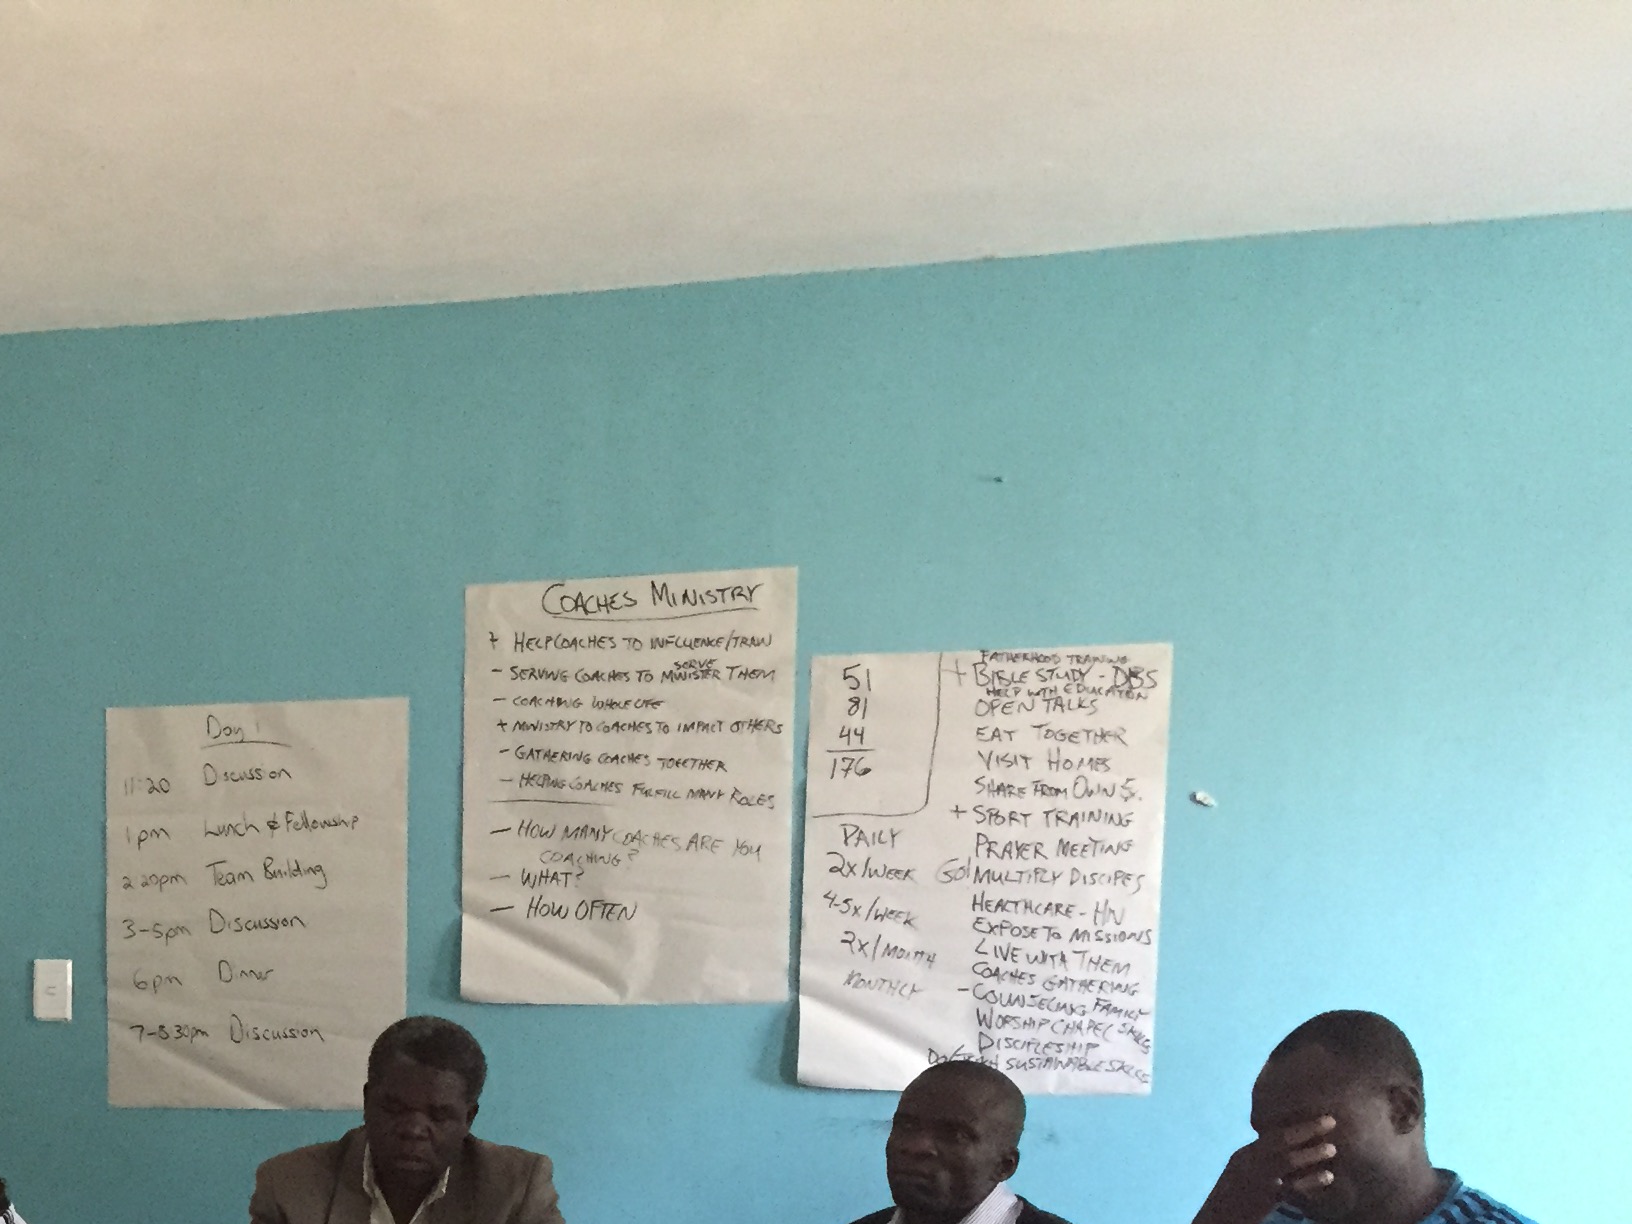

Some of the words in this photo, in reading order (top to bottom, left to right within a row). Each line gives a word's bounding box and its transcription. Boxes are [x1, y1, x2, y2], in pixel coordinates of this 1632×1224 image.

[541, 582, 638, 617] COACHES
[650, 580, 765, 608] MINISTRY
[621, 636, 644, 652] TO
[510, 664, 570, 683] SERVING
[574, 666, 632, 684] COACHES
[636, 668, 654, 684] TO
[725, 664, 776, 683] THEM
[841, 663, 873, 692] 51
[973, 662, 1031, 688] BIBLE
[1035, 664, 1095, 683] STUDY
[846, 696, 869, 721] 81
[974, 697, 1036, 718] OPEN
[1041, 694, 1100, 717] TALKS
[578, 719, 594, 734] TO
[654, 719, 670, 735] TO
[676, 719, 724, 734] IMPACT
[730, 717, 784, 736] OTHERS
[838, 725, 866, 746] 44
[975, 725, 1019, 743] EAT
[1030, 721, 1130, 747] TOGETHER
[514, 744, 592, 766] GATHERING
[829, 755, 873, 780] 176
[977, 749, 1033, 772] VISIT
[1047, 746, 1112, 774] HOMES
[202, 762, 293, 787] Dscusson
[973, 775, 1028, 799] SHARE
[1072, 774, 1117, 800] OWN
[729, 786, 776, 811] ROLES
[204, 810, 260, 838] Lunch
[972, 804, 1033, 828] SPORT
[1042, 808, 1135, 829] TRAINING
[516, 818, 558, 841] HOW
[562, 825, 614, 842] MANY
[685, 835, 724, 854] ARE
[975, 832, 1049, 861] PRAYER
[1055, 836, 1135, 858] MEETING
[122, 873, 188, 893] 220pm
[205, 859, 255, 886] Team
[262, 856, 329, 890] Building
[519, 867, 586, 890] WHAT?
[972, 865, 1063, 886] MULTIPLY
[525, 894, 571, 919] HOW
[573, 898, 640, 922] OFTEN
[972, 915, 1042, 940] EXPOSE
[1068, 927, 1153, 947] MISSIONS
[974, 937, 1018, 963] LIVE
[1072, 949, 1132, 979] THEM
[971, 960, 1037, 986] COACHES
[1042, 975, 1141, 998] GATHERING
[129, 1023, 210, 1045] 7-830pm
